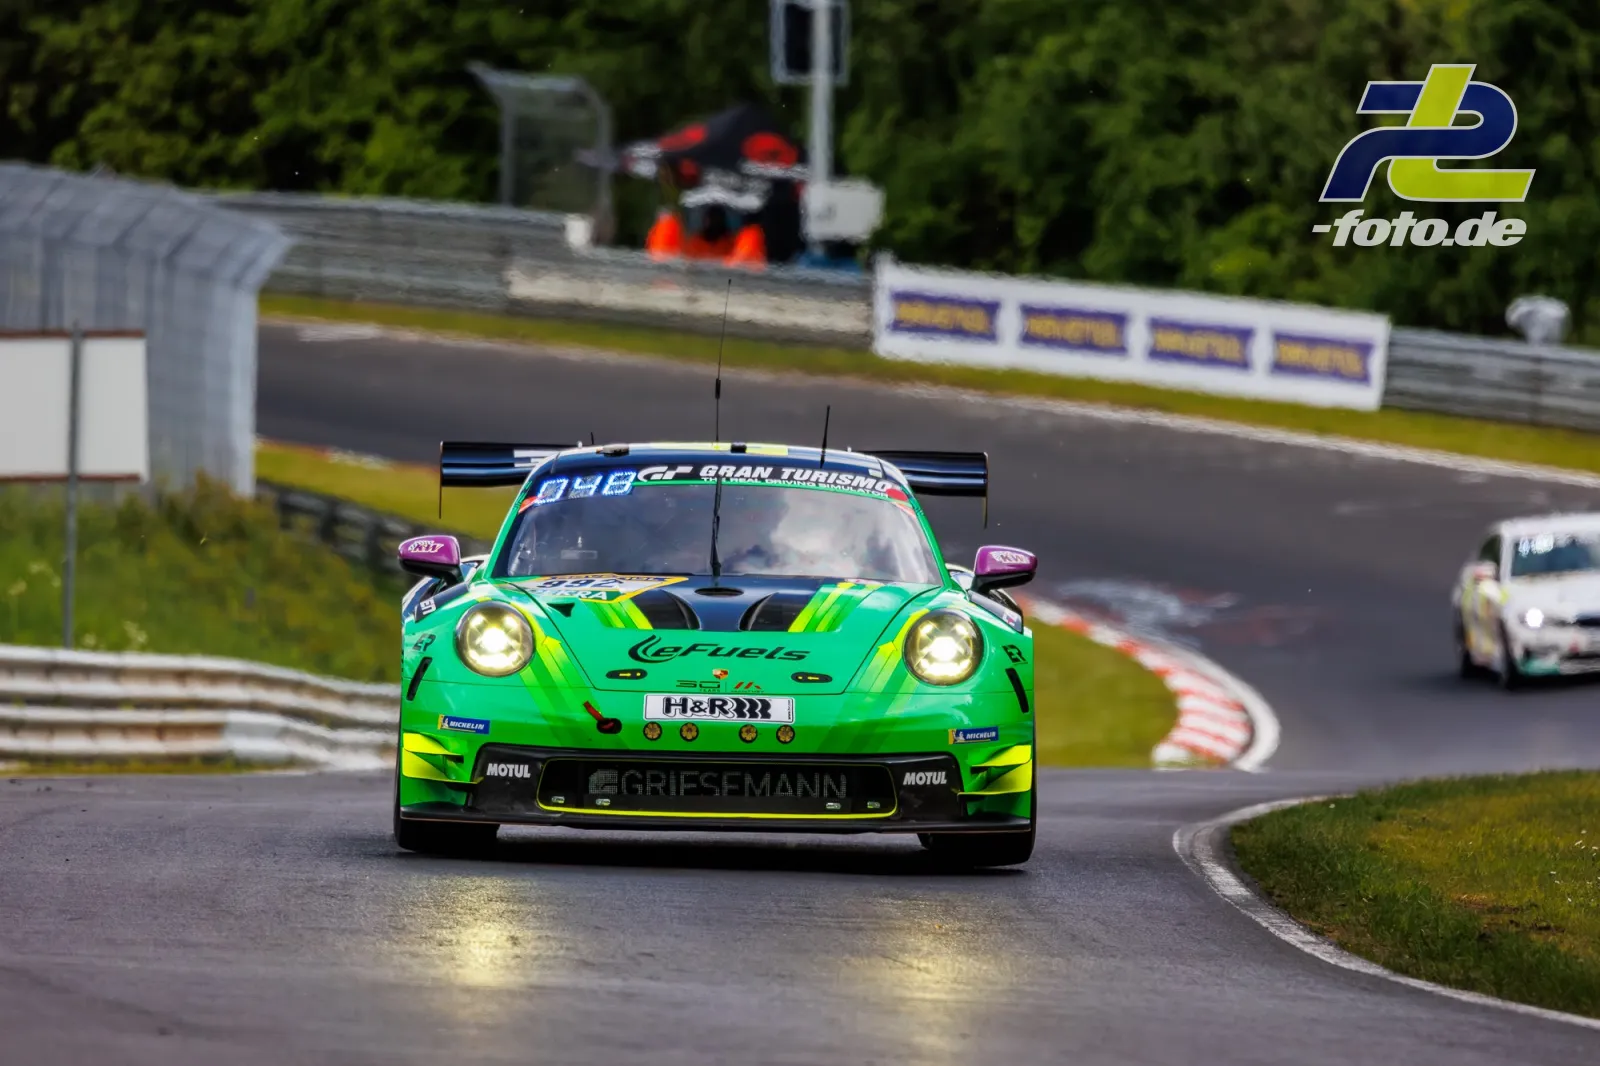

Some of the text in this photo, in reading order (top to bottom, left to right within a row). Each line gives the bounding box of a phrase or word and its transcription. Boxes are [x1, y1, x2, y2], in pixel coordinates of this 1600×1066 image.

[699, 464, 893, 493] GRAN TURISMO
[535, 469, 637, 504] 048
[449, 720, 485, 730] MICHELIN
[965, 731, 996, 739] MICHELIN
[486, 763, 531, 778] MOTUL
[902, 771, 948, 786] MOTUL
